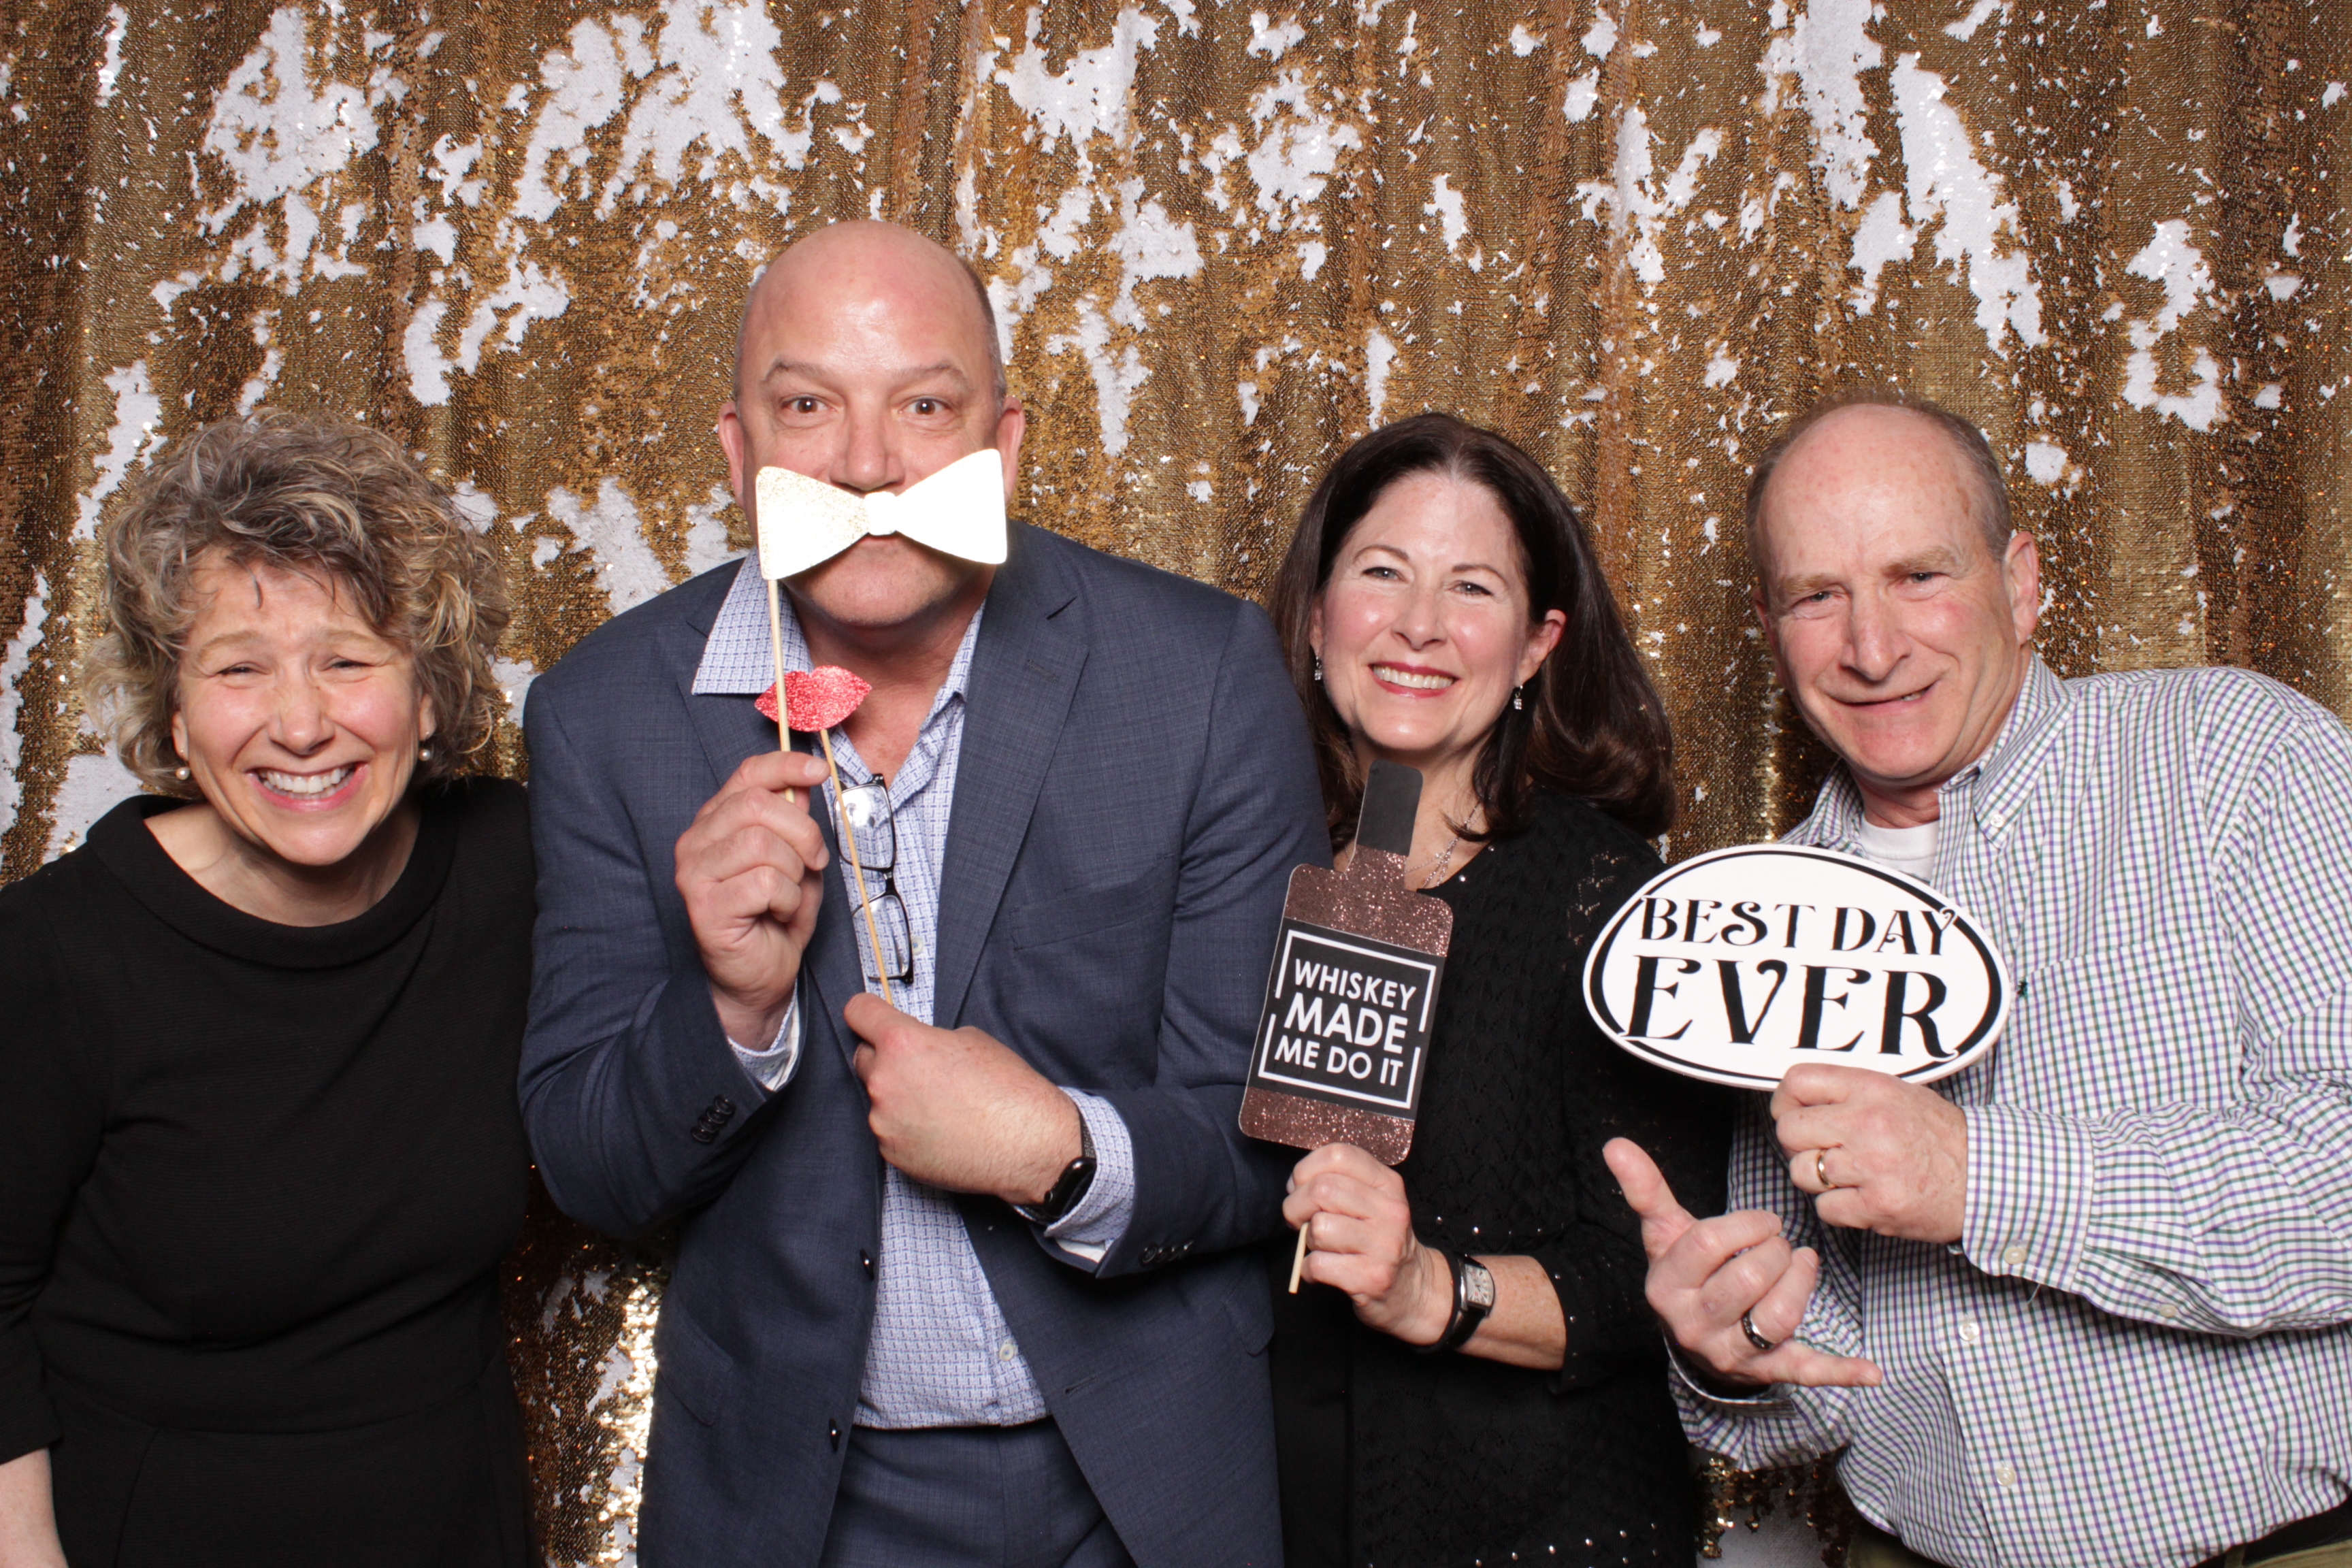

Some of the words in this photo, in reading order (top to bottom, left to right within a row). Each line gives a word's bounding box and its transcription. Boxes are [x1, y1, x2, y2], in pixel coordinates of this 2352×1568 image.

[1638, 896, 1816, 949] BEST
[1829, 906, 1958, 956] DAY
[1294, 958, 1417, 1011] WHISKEY
[1619, 955, 1959, 1061] EVER
[1283, 992, 1409, 1054] MADE
[1273, 1034, 1320, 1069] ME
[1326, 1045, 1373, 1079] DO
[1379, 1058, 1404, 1087] IT
